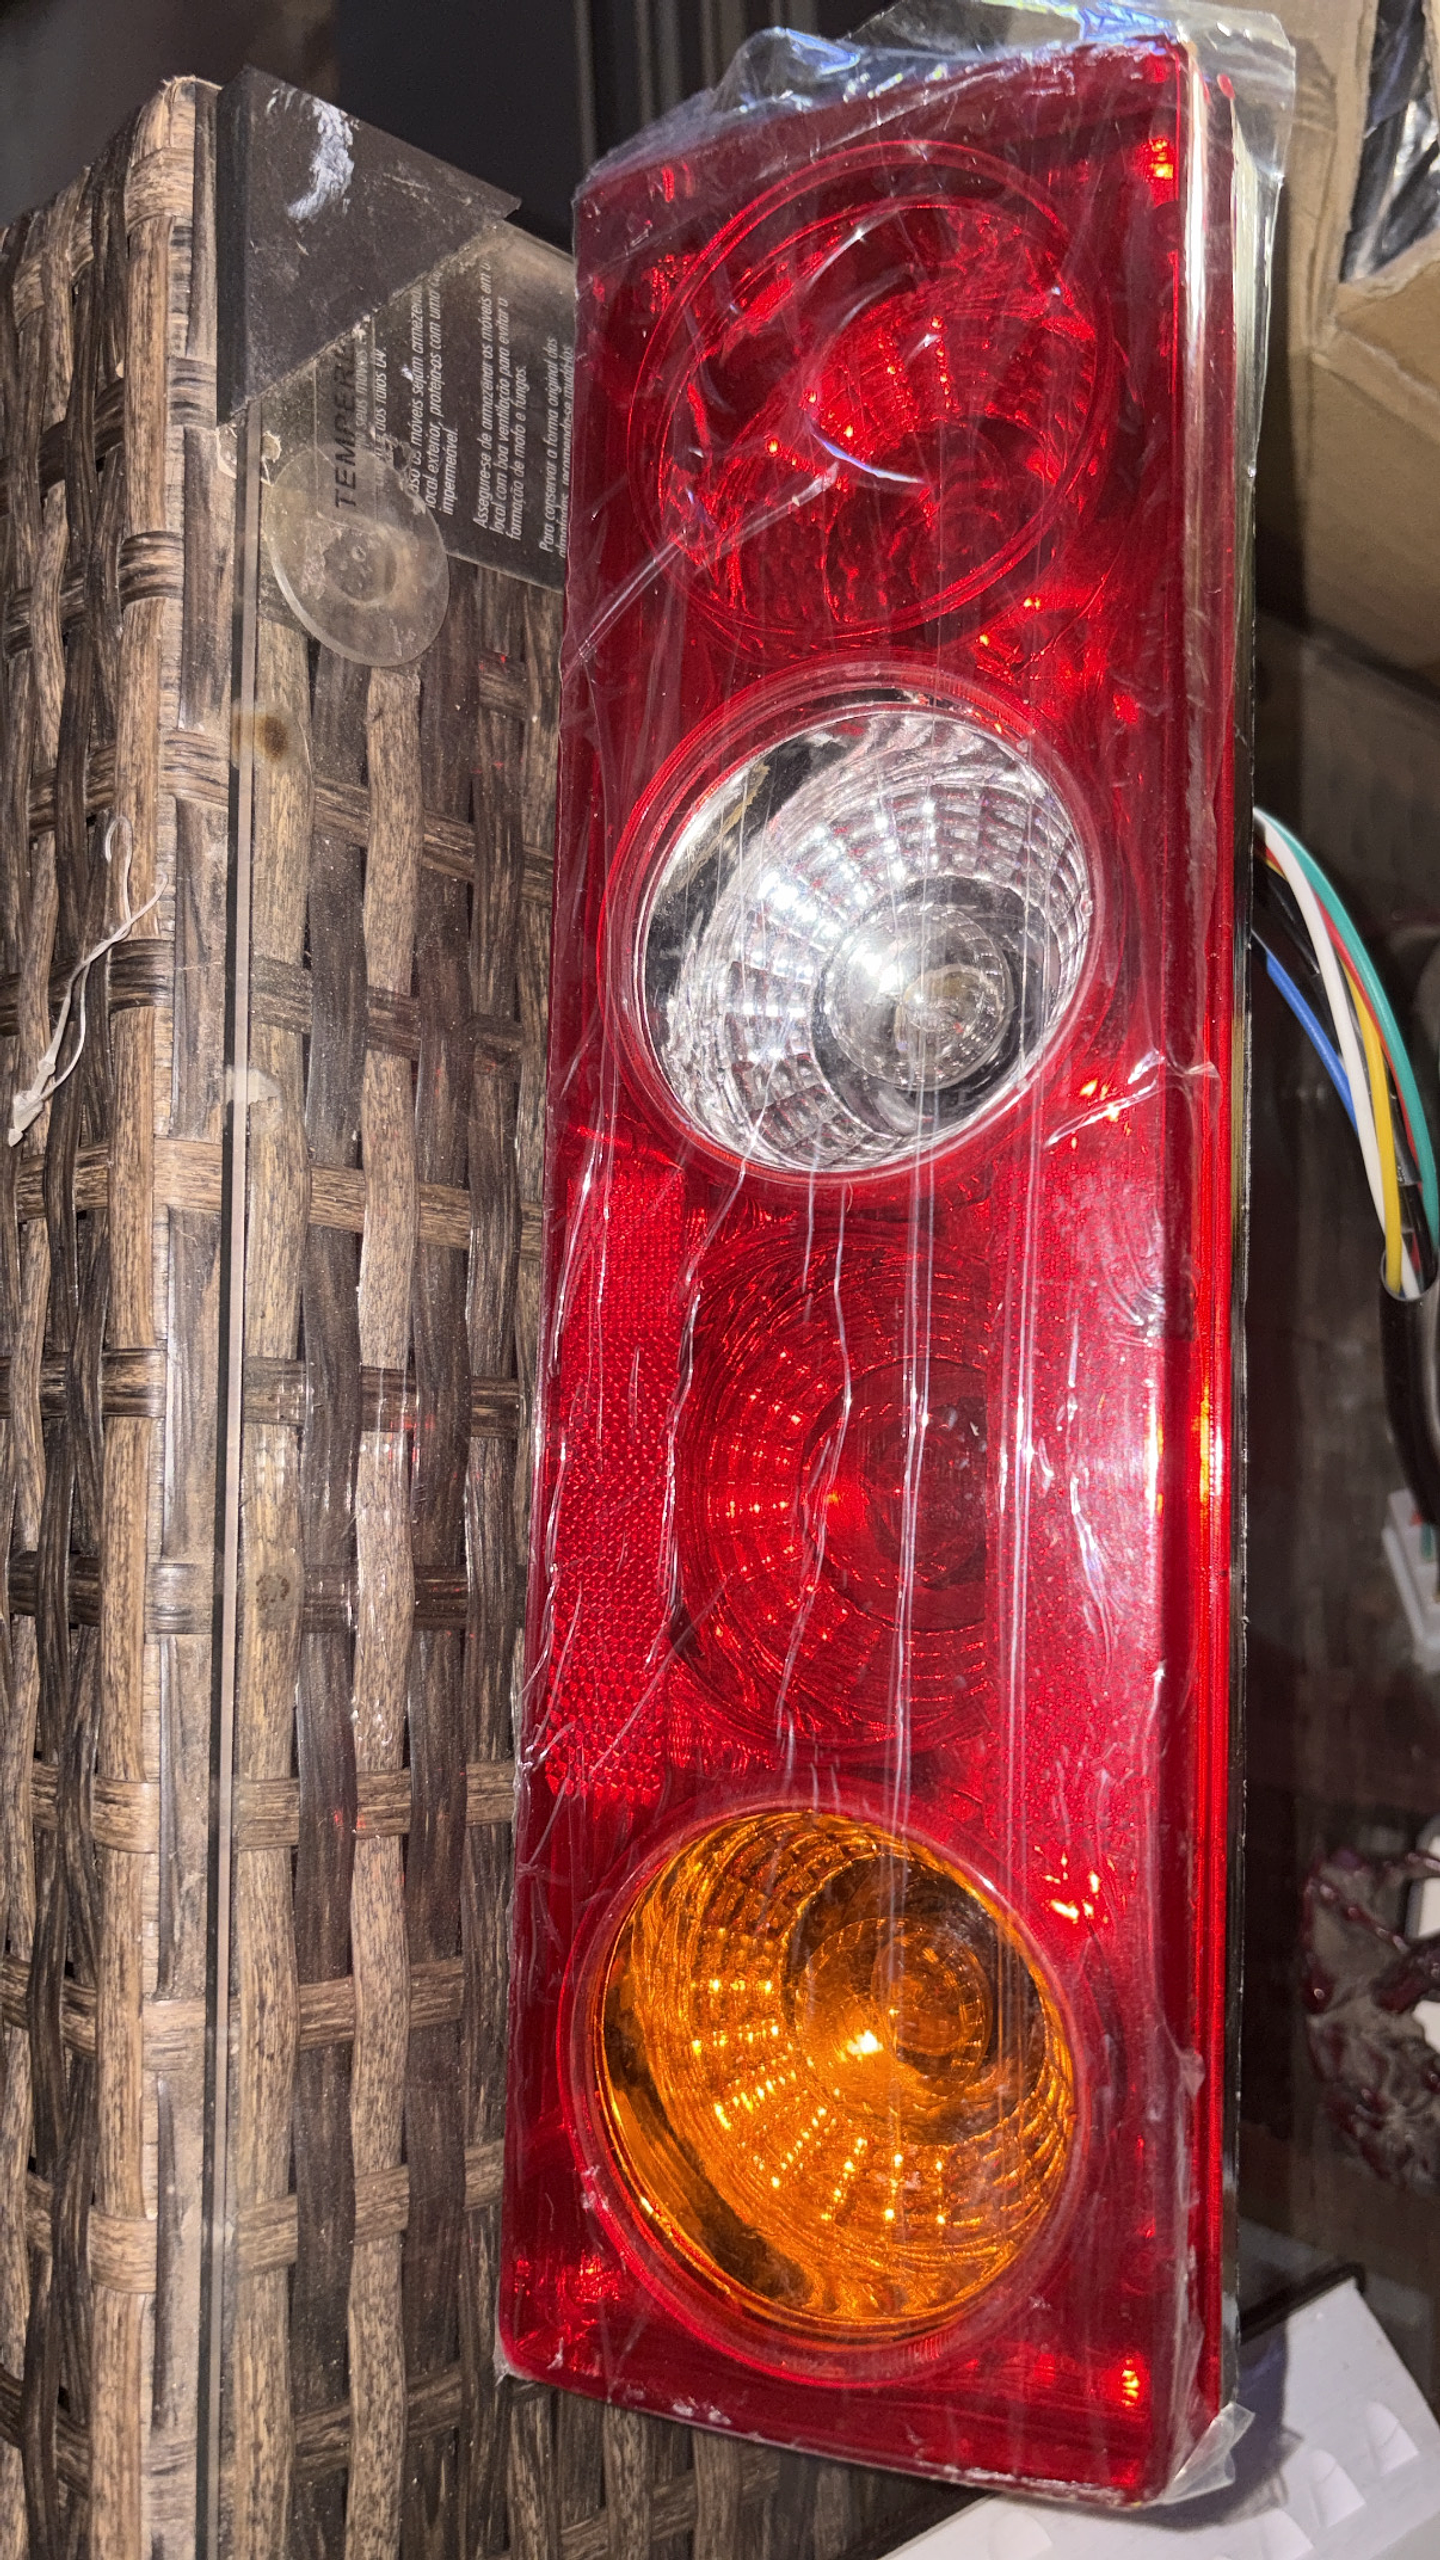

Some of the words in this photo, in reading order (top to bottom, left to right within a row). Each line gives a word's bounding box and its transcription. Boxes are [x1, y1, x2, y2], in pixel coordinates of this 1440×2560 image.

[480, 273, 492, 294] em
[428, 289, 441, 319] uma
[478, 295, 494, 342] móveis
[429, 322, 441, 350] com
[495, 308, 510, 345] evitar
[481, 344, 494, 360] os
[498, 346, 514, 378] para
[542, 336, 558, 358] das
[374, 371, 386, 404] raios
[409, 356, 427, 397] sejam
[426, 352, 446, 418] proteja-os
[510, 365, 530, 410] fungos.
[544, 358, 562, 406] original
[480, 359, 494, 430] armazenar
[494, 377, 511, 442] ventilação
[355, 399, 368, 429] seus
[408, 398, 424, 446] móveis
[515, 412, 526, 422] e
[542, 409, 558, 448] forma
[426, 421, 444, 473] exterior,
[476, 432, 493, 450] de
[492, 444, 509, 470] boa
[509, 424, 526, 458] mofo
[546, 449, 558, 460] a
[439, 428, 458, 515] impermeável.
[509, 460, 525, 478] de
[422, 474, 438, 508] local
[472, 452, 492, 529] Assegure-se
[496, 472, 508, 501] com
[544, 461, 558, 520] conservar
[488, 502, 506, 535] local
[505, 480, 526, 541] formação
[538, 524, 555, 553] Para
